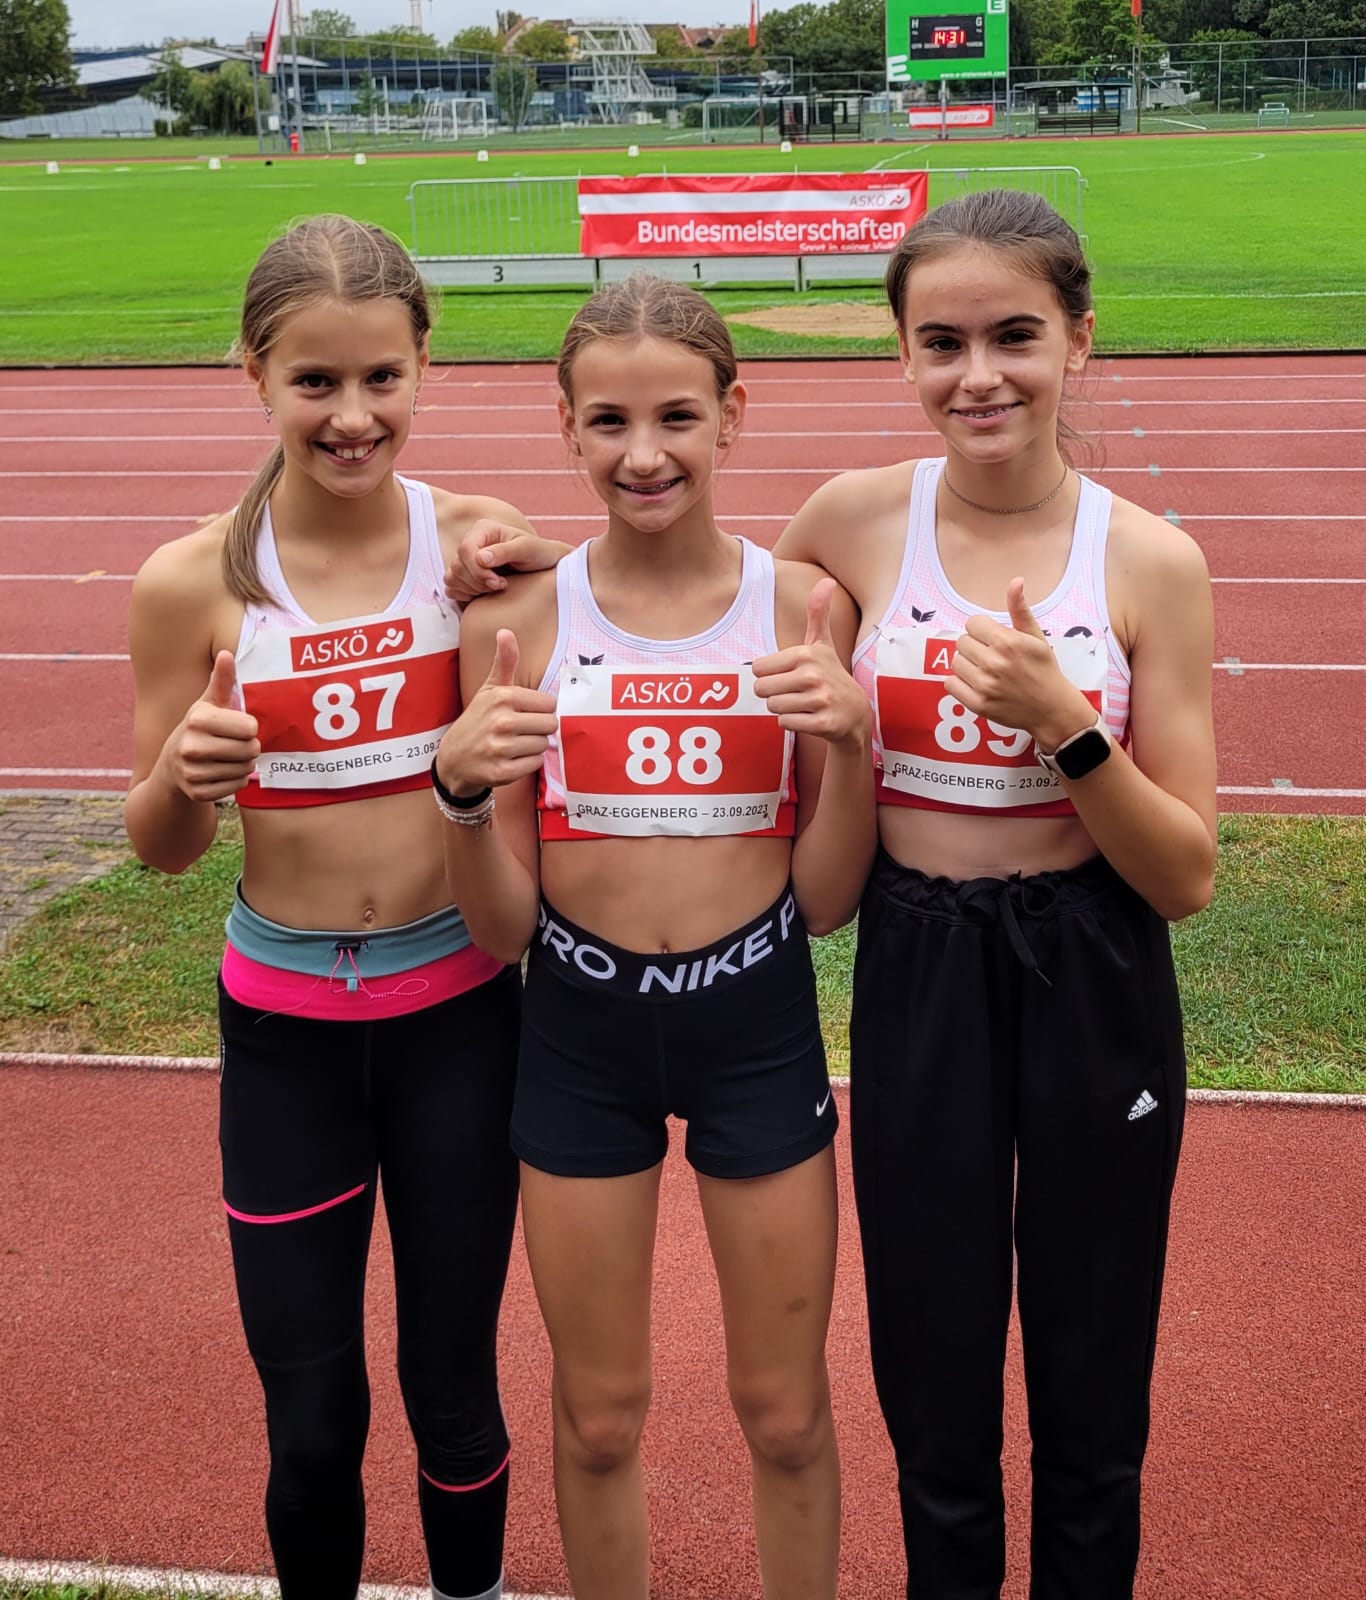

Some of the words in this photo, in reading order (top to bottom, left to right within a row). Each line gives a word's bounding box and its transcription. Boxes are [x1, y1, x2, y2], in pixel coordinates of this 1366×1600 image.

[975, 16, 983, 27] G
[934, 31, 965, 45] 14:31
[637, 217, 906, 243] Bundesmeisterschaften
[494, 266, 504, 282] 3
[692, 263, 700, 279] 1
[300, 629, 368, 666] ASKÖ
[619, 677, 693, 704] ASKÖ
[312, 671, 406, 741] 87
[934, 694, 1034, 758] 89
[270, 752, 393, 773] GRAZ-EGGENBERG
[406, 738, 441, 758] 23.09.2
[625, 726, 723, 786] 88
[894, 762, 1006, 790] GRAZ-EGGENBERG
[1019, 777, 1060, 789] 23.09.2
[578, 804, 698, 819] GRAZ-EGGENBERG
[712, 804, 768, 818] 23.09.2023
[638, 920, 774, 994] NIKE
[1128, 1100, 1158, 1120] adidas
